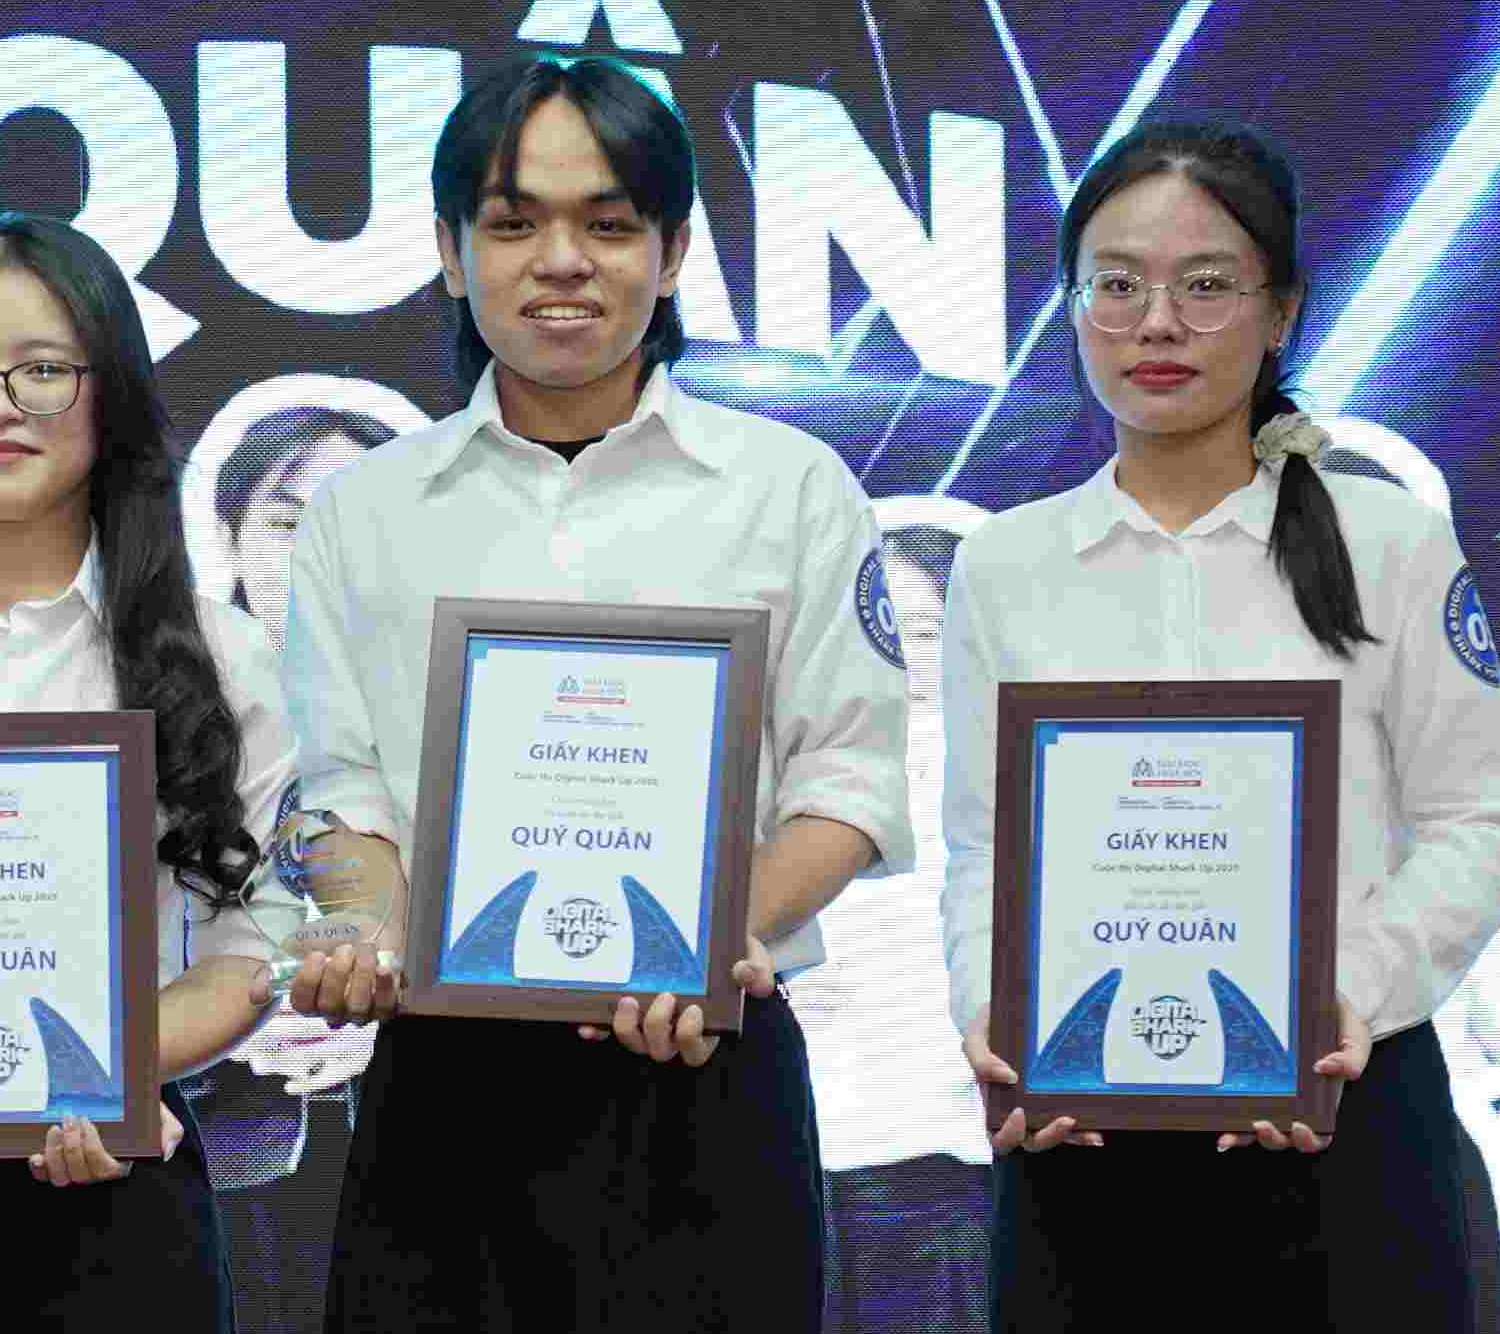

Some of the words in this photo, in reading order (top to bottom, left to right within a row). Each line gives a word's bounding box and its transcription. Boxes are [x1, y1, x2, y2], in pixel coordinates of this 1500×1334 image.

[529, 739, 581, 761] GIẤY
[586, 746, 649, 764] KHEN
[511, 824, 569, 848] QUÝ
[575, 828, 652, 851] QUÂN
[1106, 828, 1160, 851] GIẤY
[1165, 832, 1228, 851] KHEN
[1093, 918, 1150, 944] QUÝ
[1157, 918, 1237, 944] QUÂN
